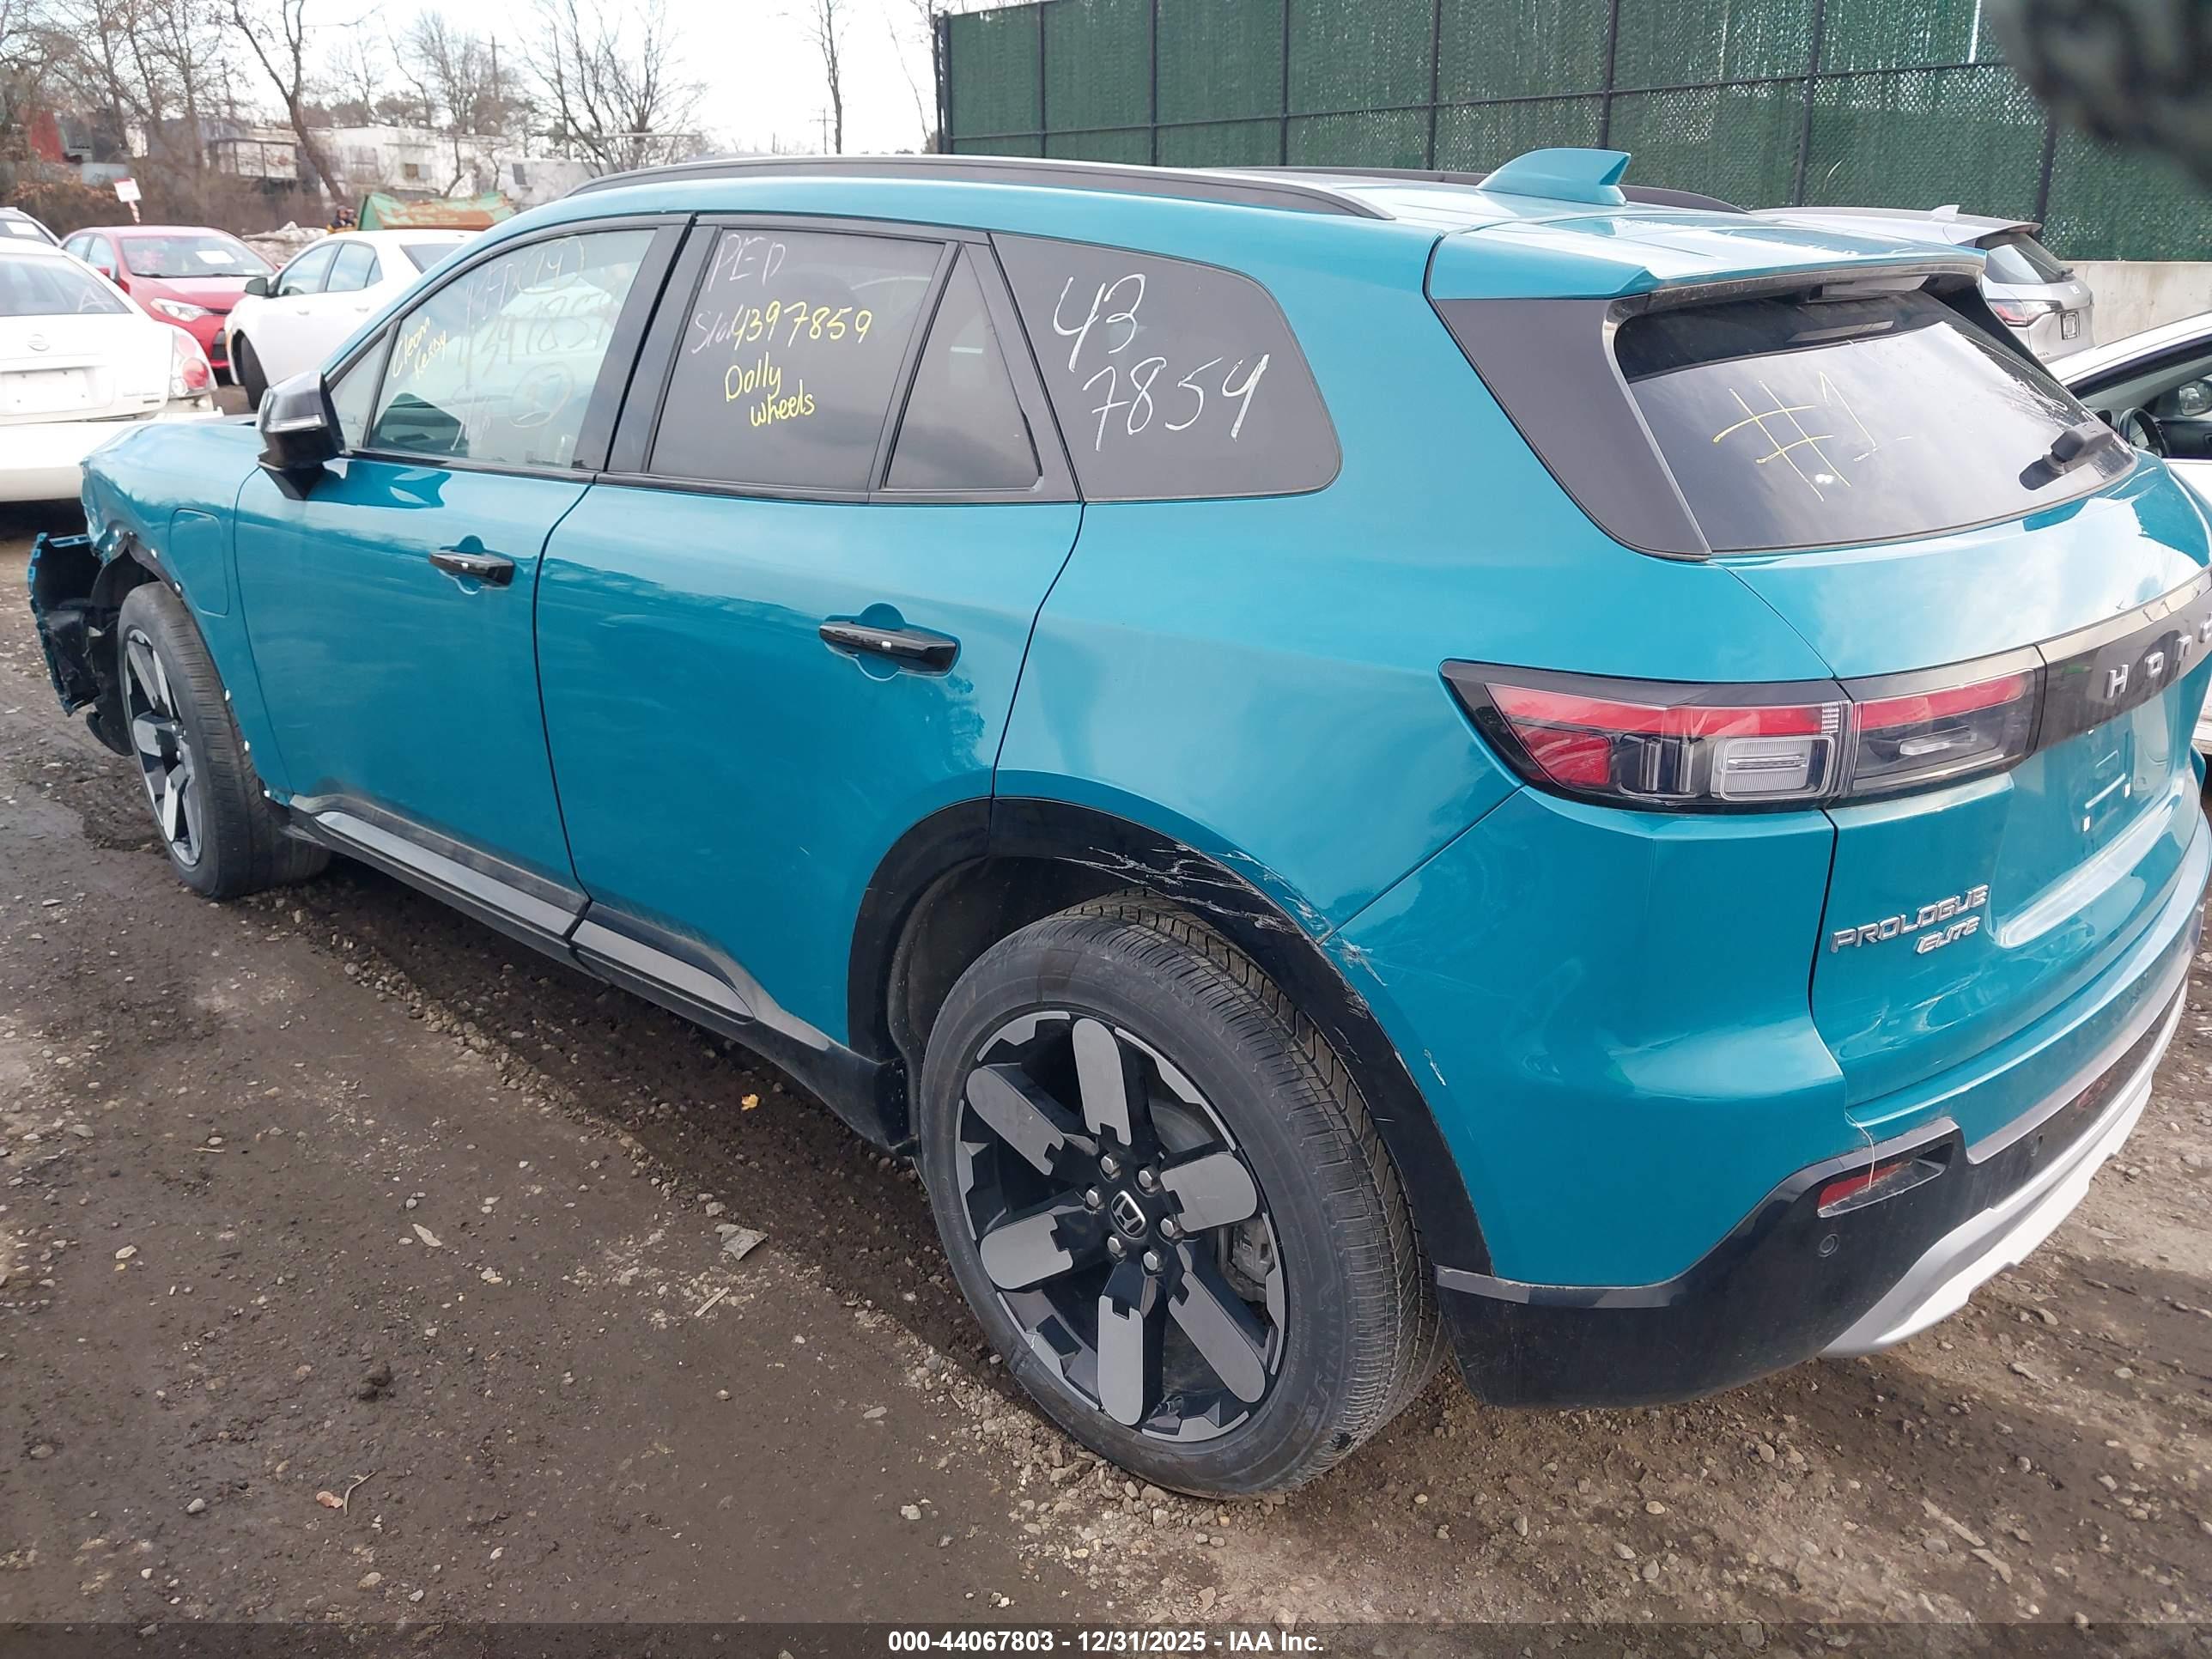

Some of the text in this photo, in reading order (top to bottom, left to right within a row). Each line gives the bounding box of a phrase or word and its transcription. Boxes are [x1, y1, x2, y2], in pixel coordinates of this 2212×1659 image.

[1053, 273, 1146, 373] 43
[725, 351, 781, 402] Dolly
[1830, 884, 1989, 953] PROLOGUE
[1914, 915, 1981, 955] ELITE
